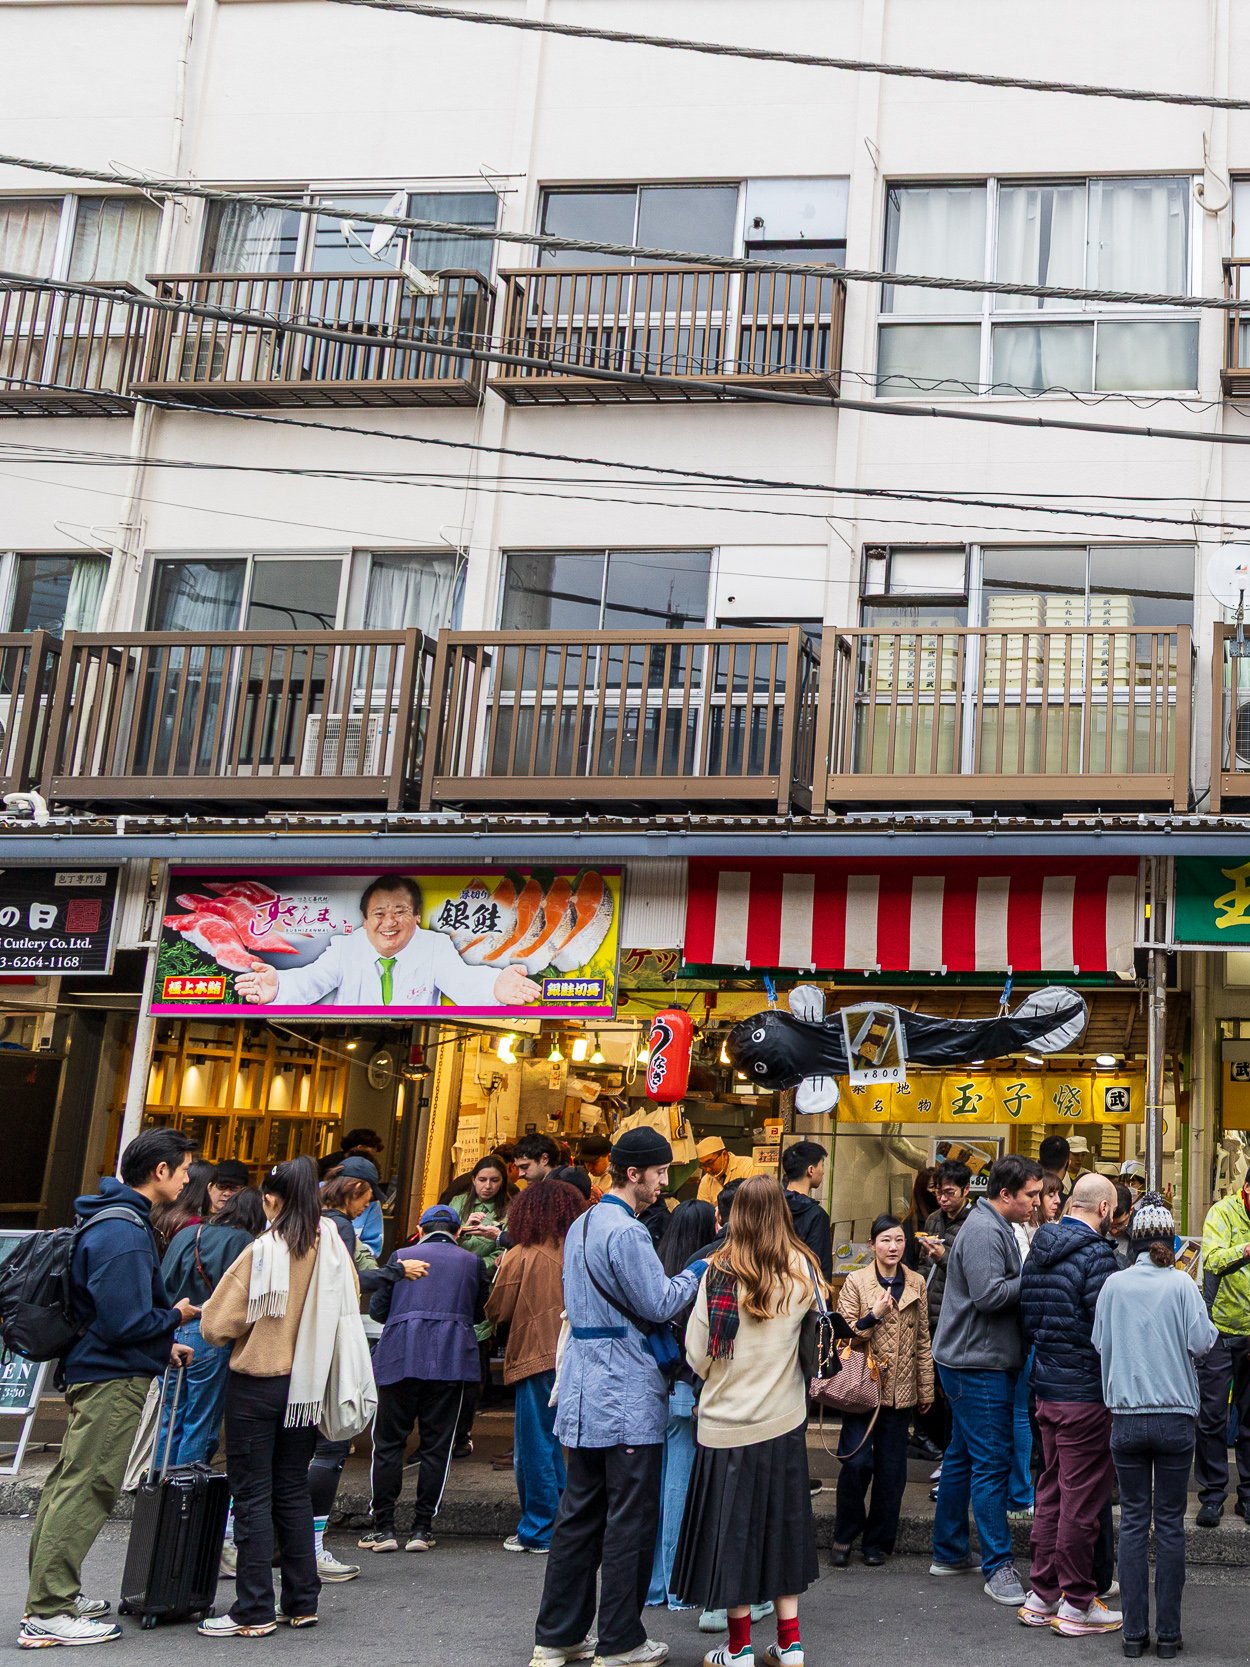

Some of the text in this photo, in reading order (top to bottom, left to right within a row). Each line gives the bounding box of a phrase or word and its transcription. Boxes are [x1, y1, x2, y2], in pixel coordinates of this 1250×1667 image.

[58, 874, 103, 884] 包丁専門店
[437, 899, 503, 934] 銀鮭
[4, 938, 92, 952] Cutlery Co. Ltd.
[547, 981, 600, 997] 銀鮭切身
[648, 1018, 674, 1093] うなぎ
[863, 1068, 899, 1079] ¥800
[872, 1098, 932, 1112] 名物
[970, 1176, 987, 1185] ¥80
[0, 1363, 34, 1379] EN
